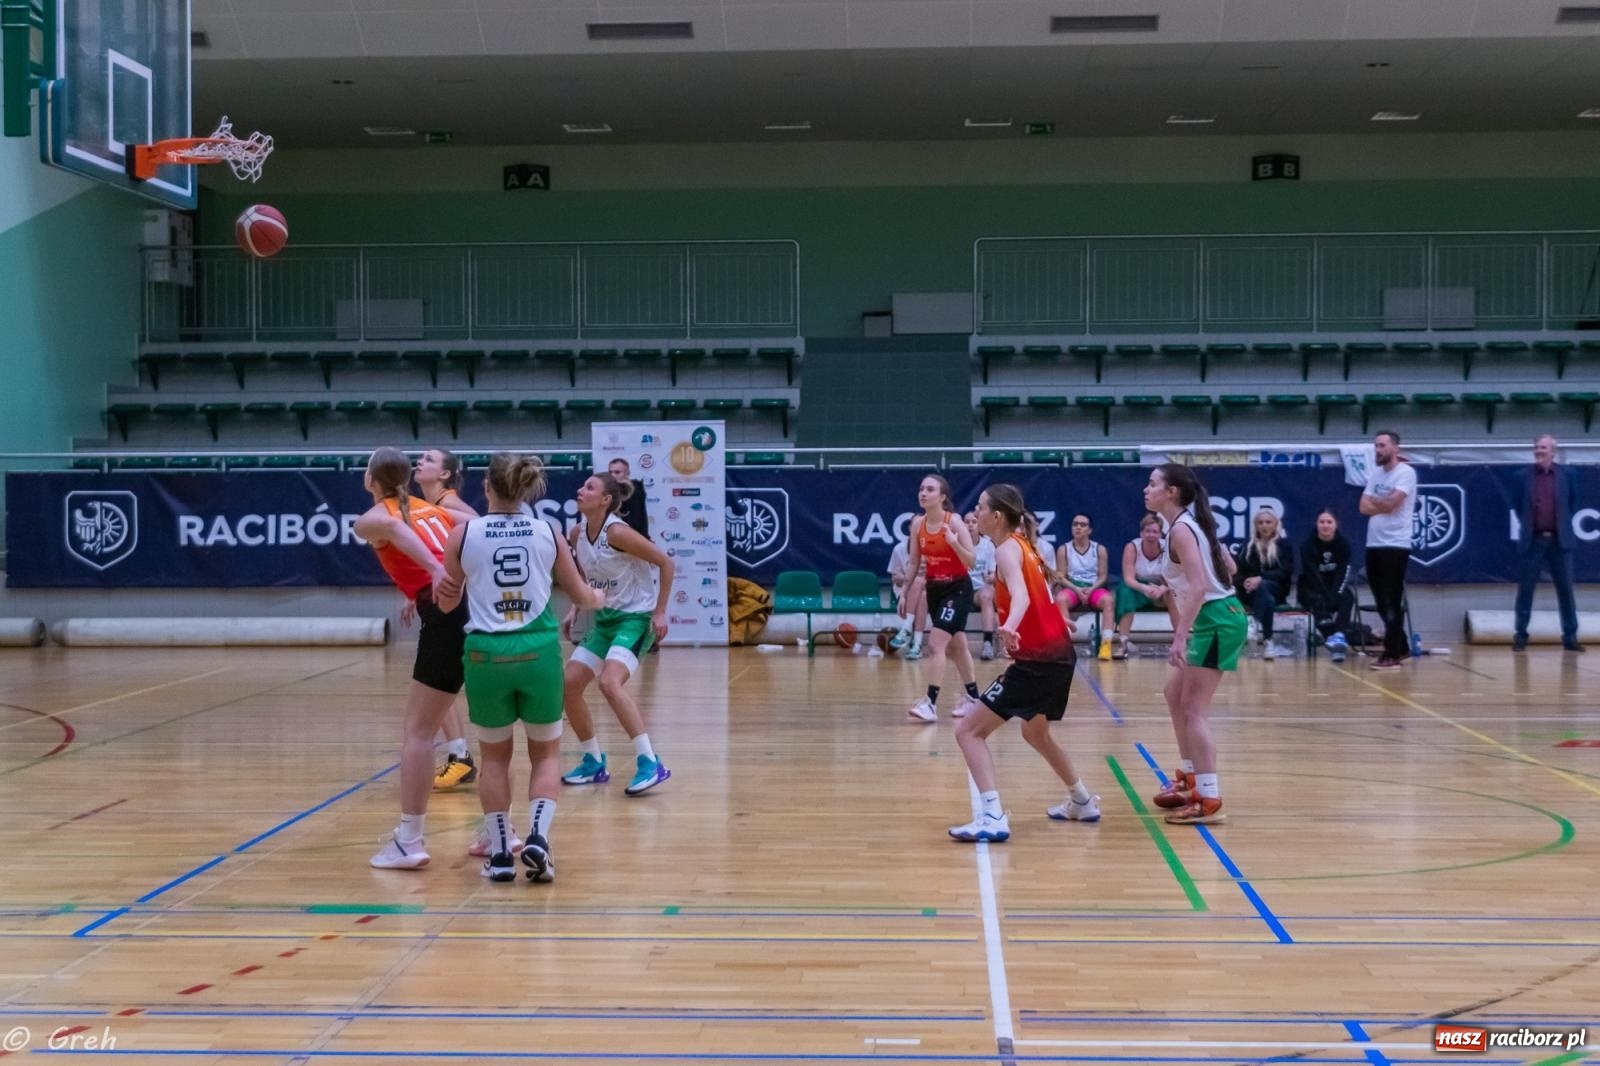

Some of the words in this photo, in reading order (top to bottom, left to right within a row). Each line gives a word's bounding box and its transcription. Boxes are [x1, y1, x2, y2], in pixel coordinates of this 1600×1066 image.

[507, 173, 520, 187] A
[527, 172, 545, 187] A
[1258, 163, 1272, 178] B
[1283, 162, 1296, 177] B
[178, 502, 367, 546] RACIBÓR
[415, 515, 449, 553] 11
[492, 546, 530, 588] 3
[940, 606, 955, 622] 13
[984, 680, 1004, 703] 12
